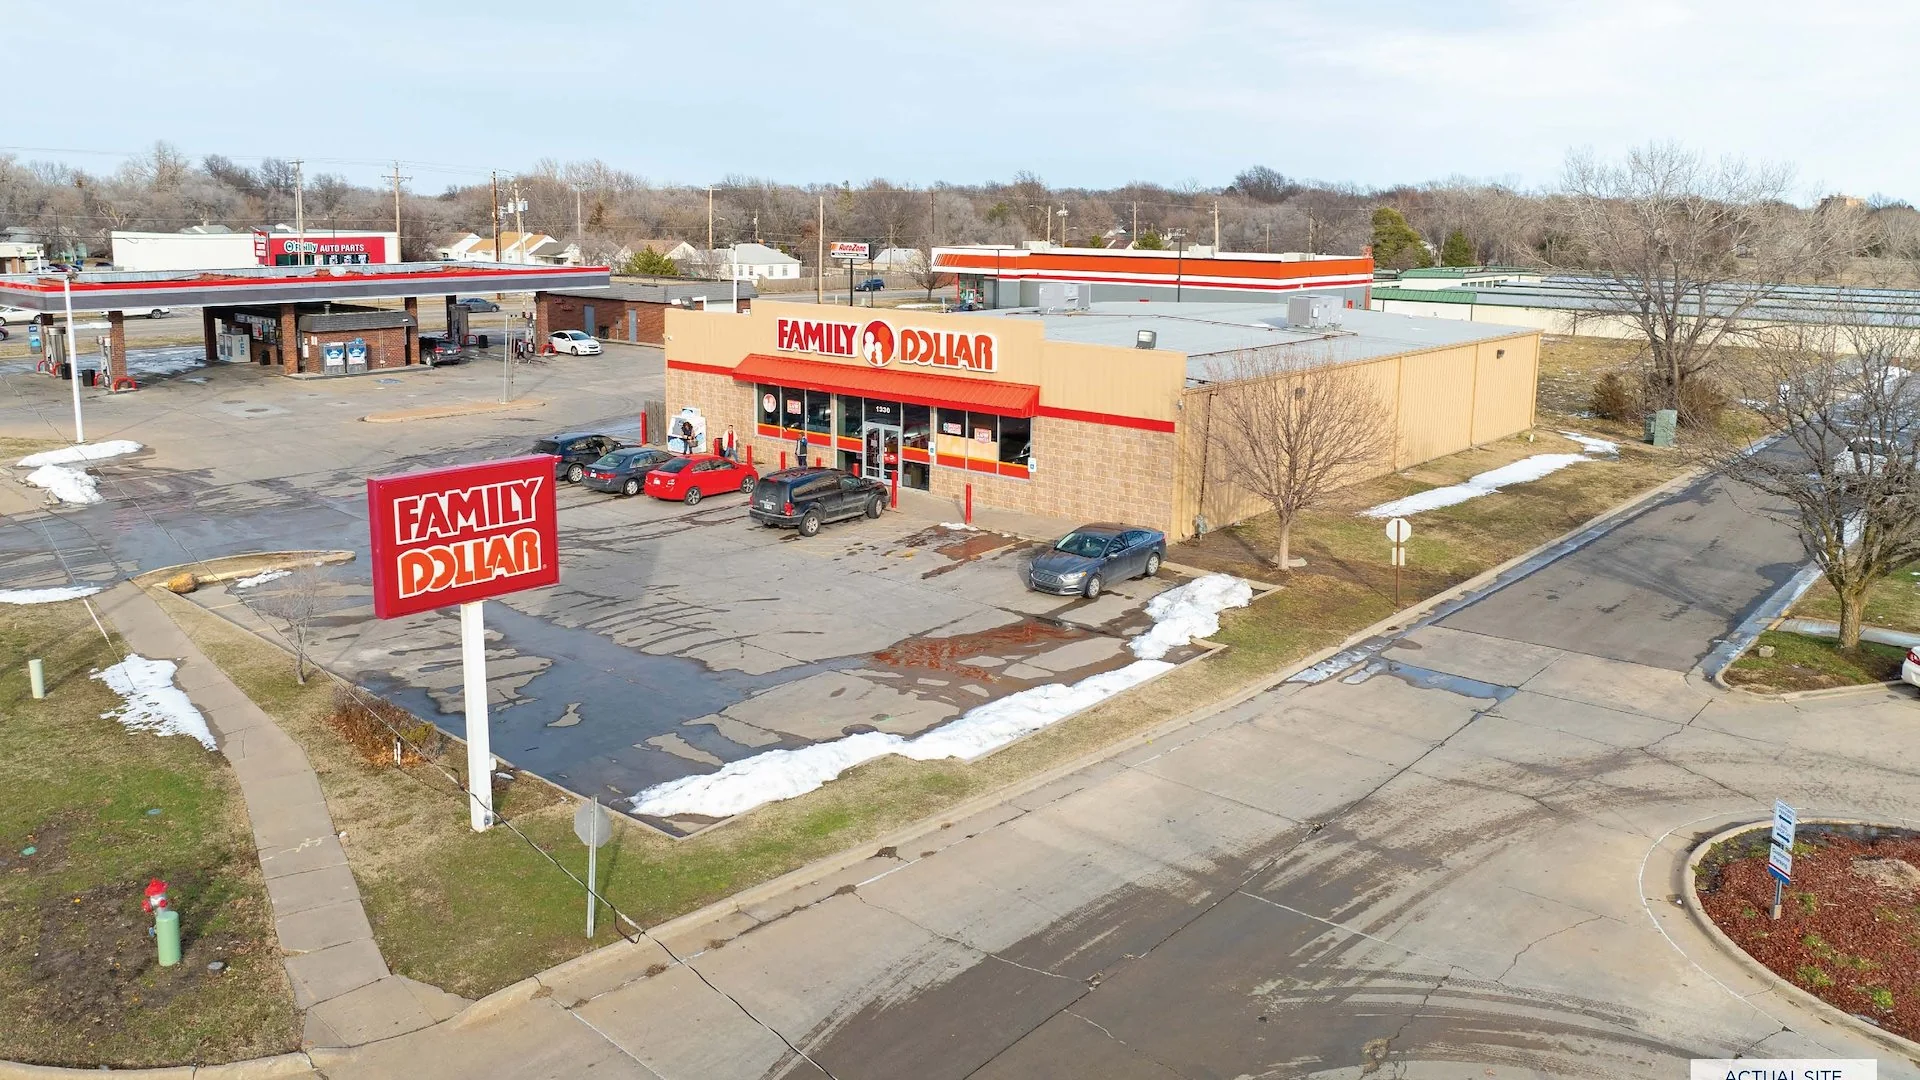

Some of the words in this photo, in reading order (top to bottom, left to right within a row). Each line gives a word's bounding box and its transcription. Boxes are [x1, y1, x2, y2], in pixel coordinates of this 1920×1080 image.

[320, 244, 339, 252] AUTO
[341, 244, 364, 252] PARTS
[777, 318, 858, 356] FAMILY
[900, 328, 993, 371] DOLLAR
[393, 476, 544, 546] FAMILY
[397, 527, 542, 600] DOLLAR
